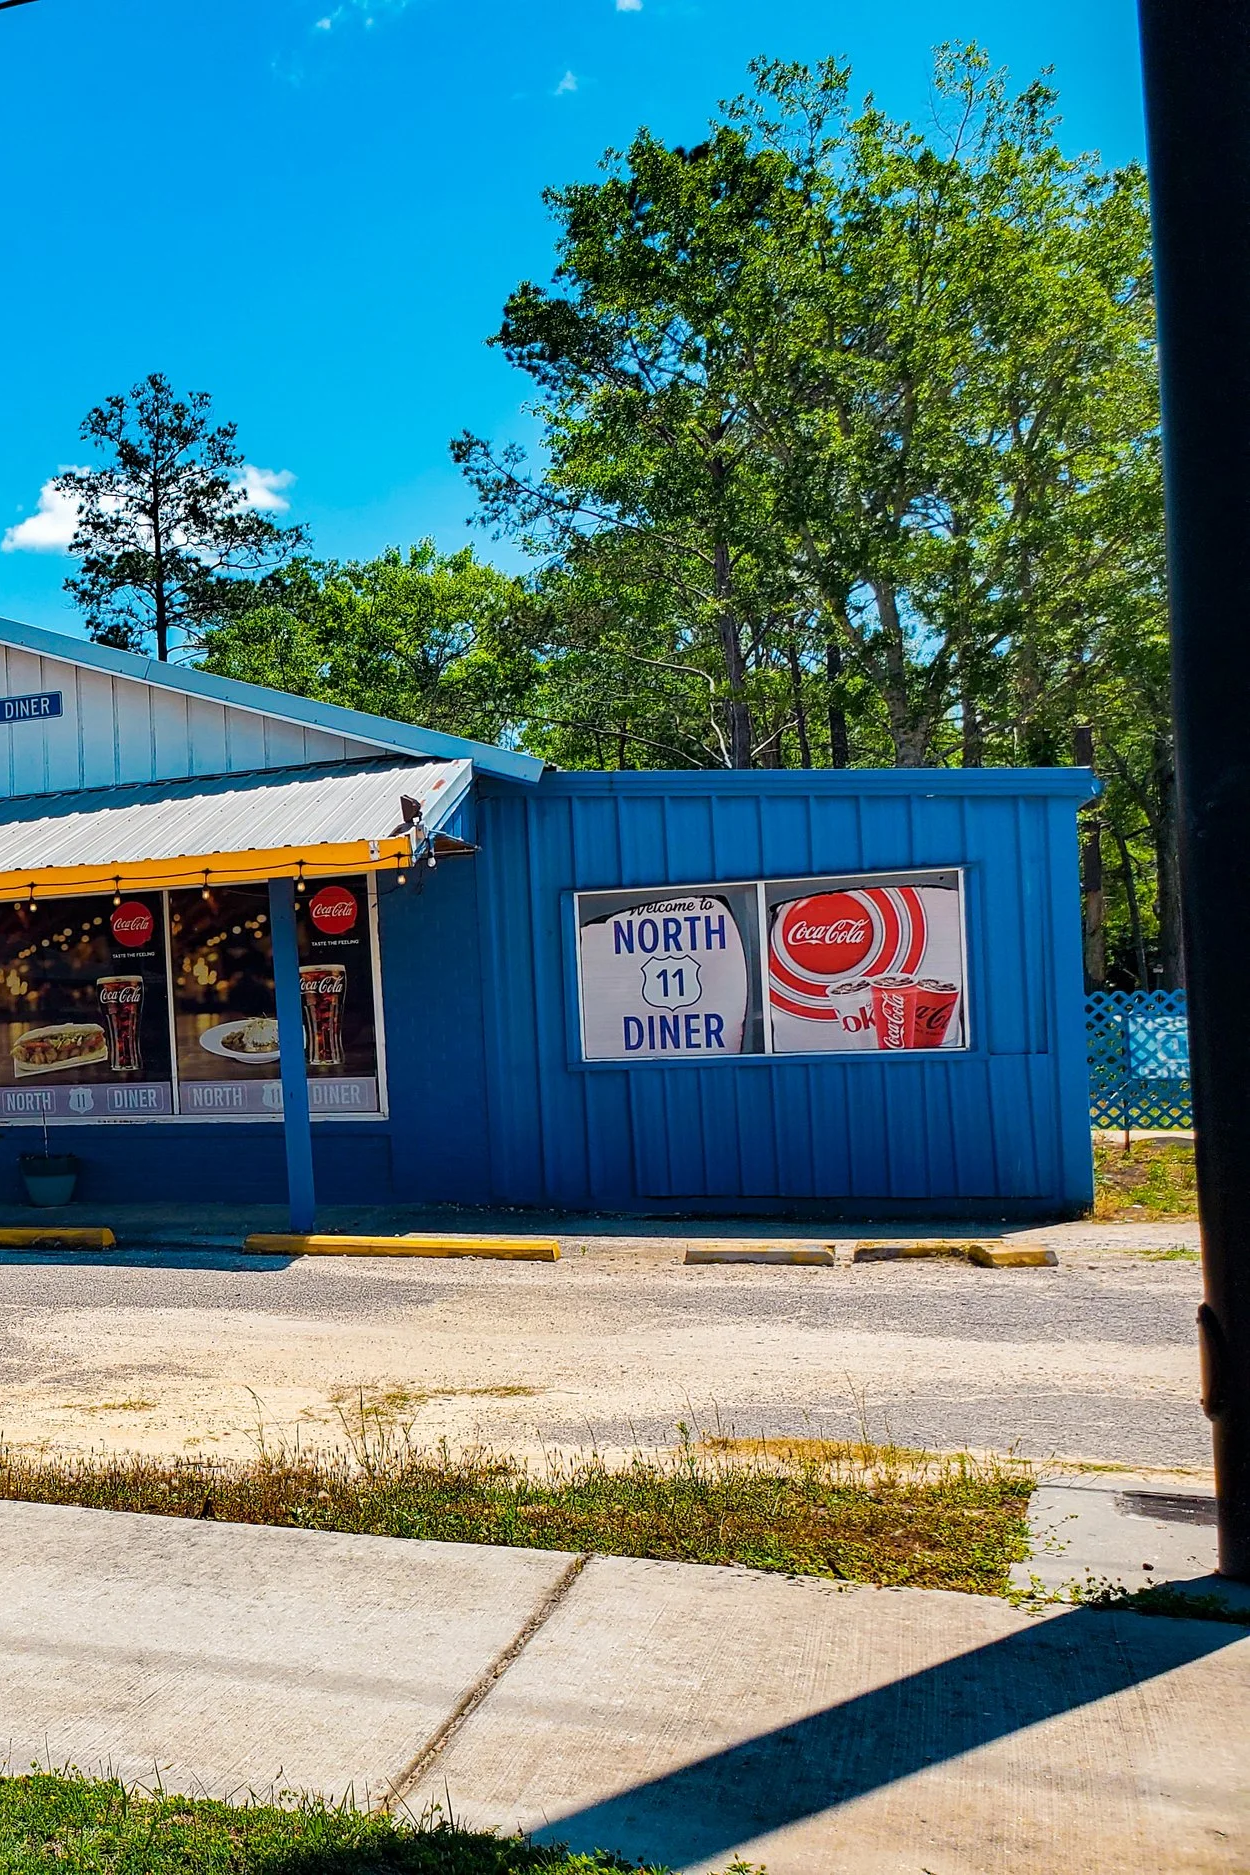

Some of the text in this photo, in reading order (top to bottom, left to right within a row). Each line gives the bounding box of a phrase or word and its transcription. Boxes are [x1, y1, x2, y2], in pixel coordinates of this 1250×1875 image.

[5, 697, 50, 719] DINER
[312, 901, 355, 918] Coca-Cola
[630, 897, 714, 916] Welcome to
[113, 916, 152, 931] Coca-Cola
[613, 915, 726, 954] NORTH
[787, 918, 870, 946] Coca-Cola
[656, 968, 684, 997] 11
[100, 985, 142, 1004] Coca-Cola
[881, 990, 905, 1049] Coca-Cola
[623, 1013, 725, 1051] DINER
[6, 1089, 158, 1112] NORTH 11 DINER
[192, 1087, 242, 1107] NORTH
[312, 1085, 361, 1104] DINER
